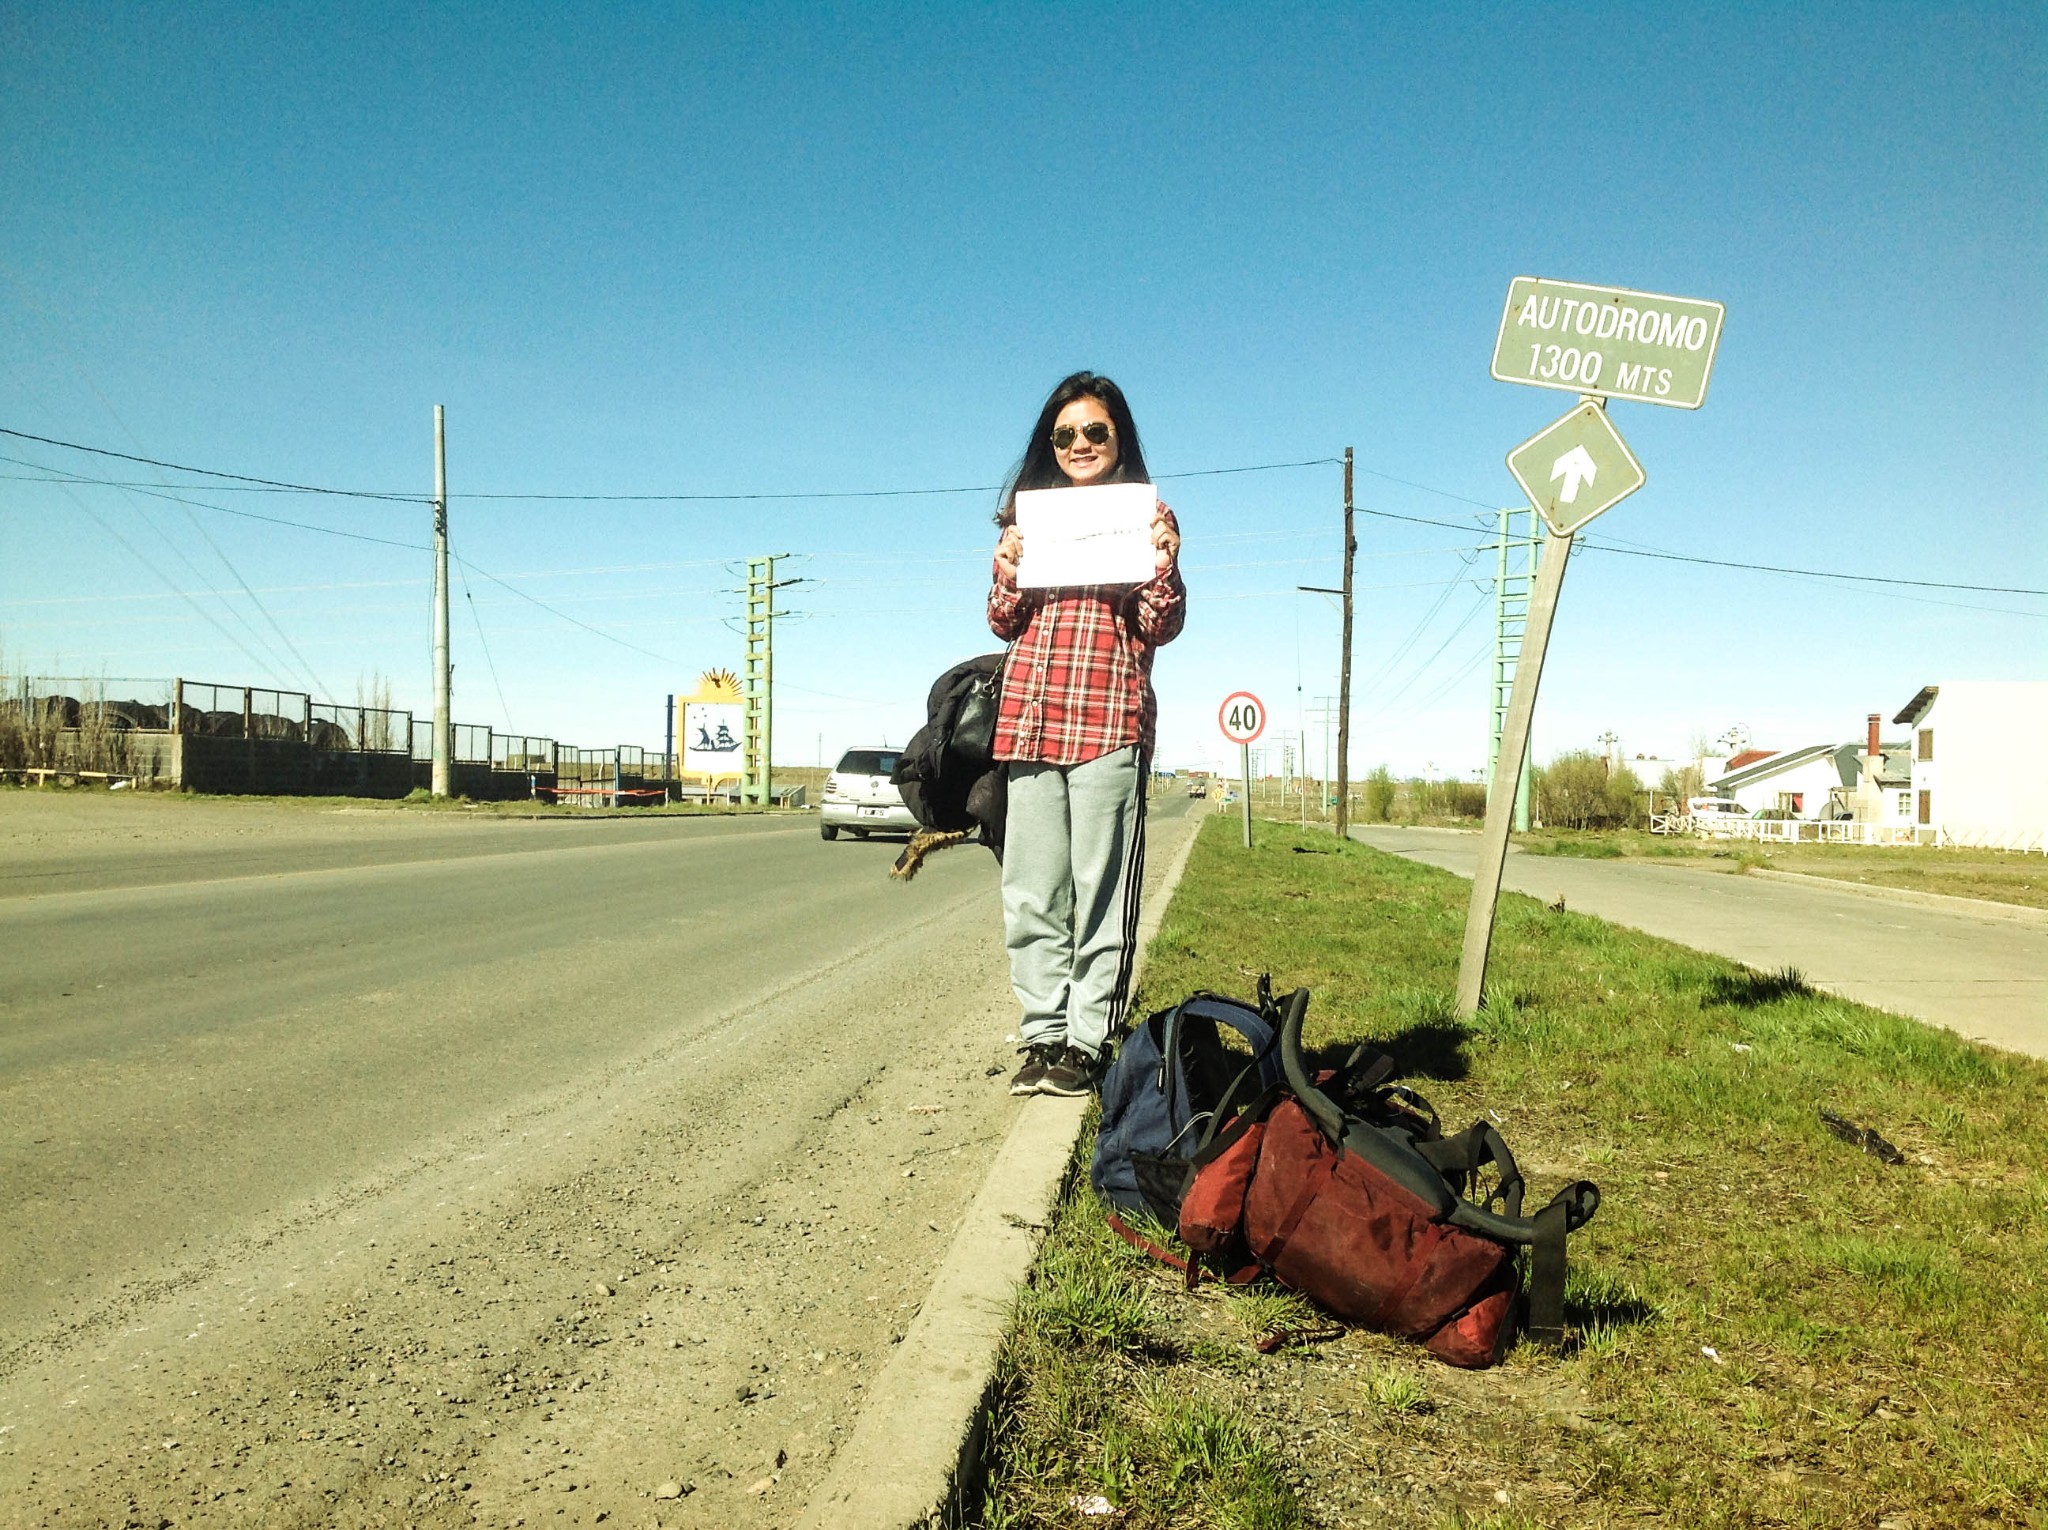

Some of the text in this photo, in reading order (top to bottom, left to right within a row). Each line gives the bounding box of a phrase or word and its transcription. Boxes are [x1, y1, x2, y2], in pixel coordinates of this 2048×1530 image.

[1518, 295, 1708, 351] AUTODROMO
[1529, 344, 1673, 395] 1300 MTS
[1229, 704, 1256, 731] 40
